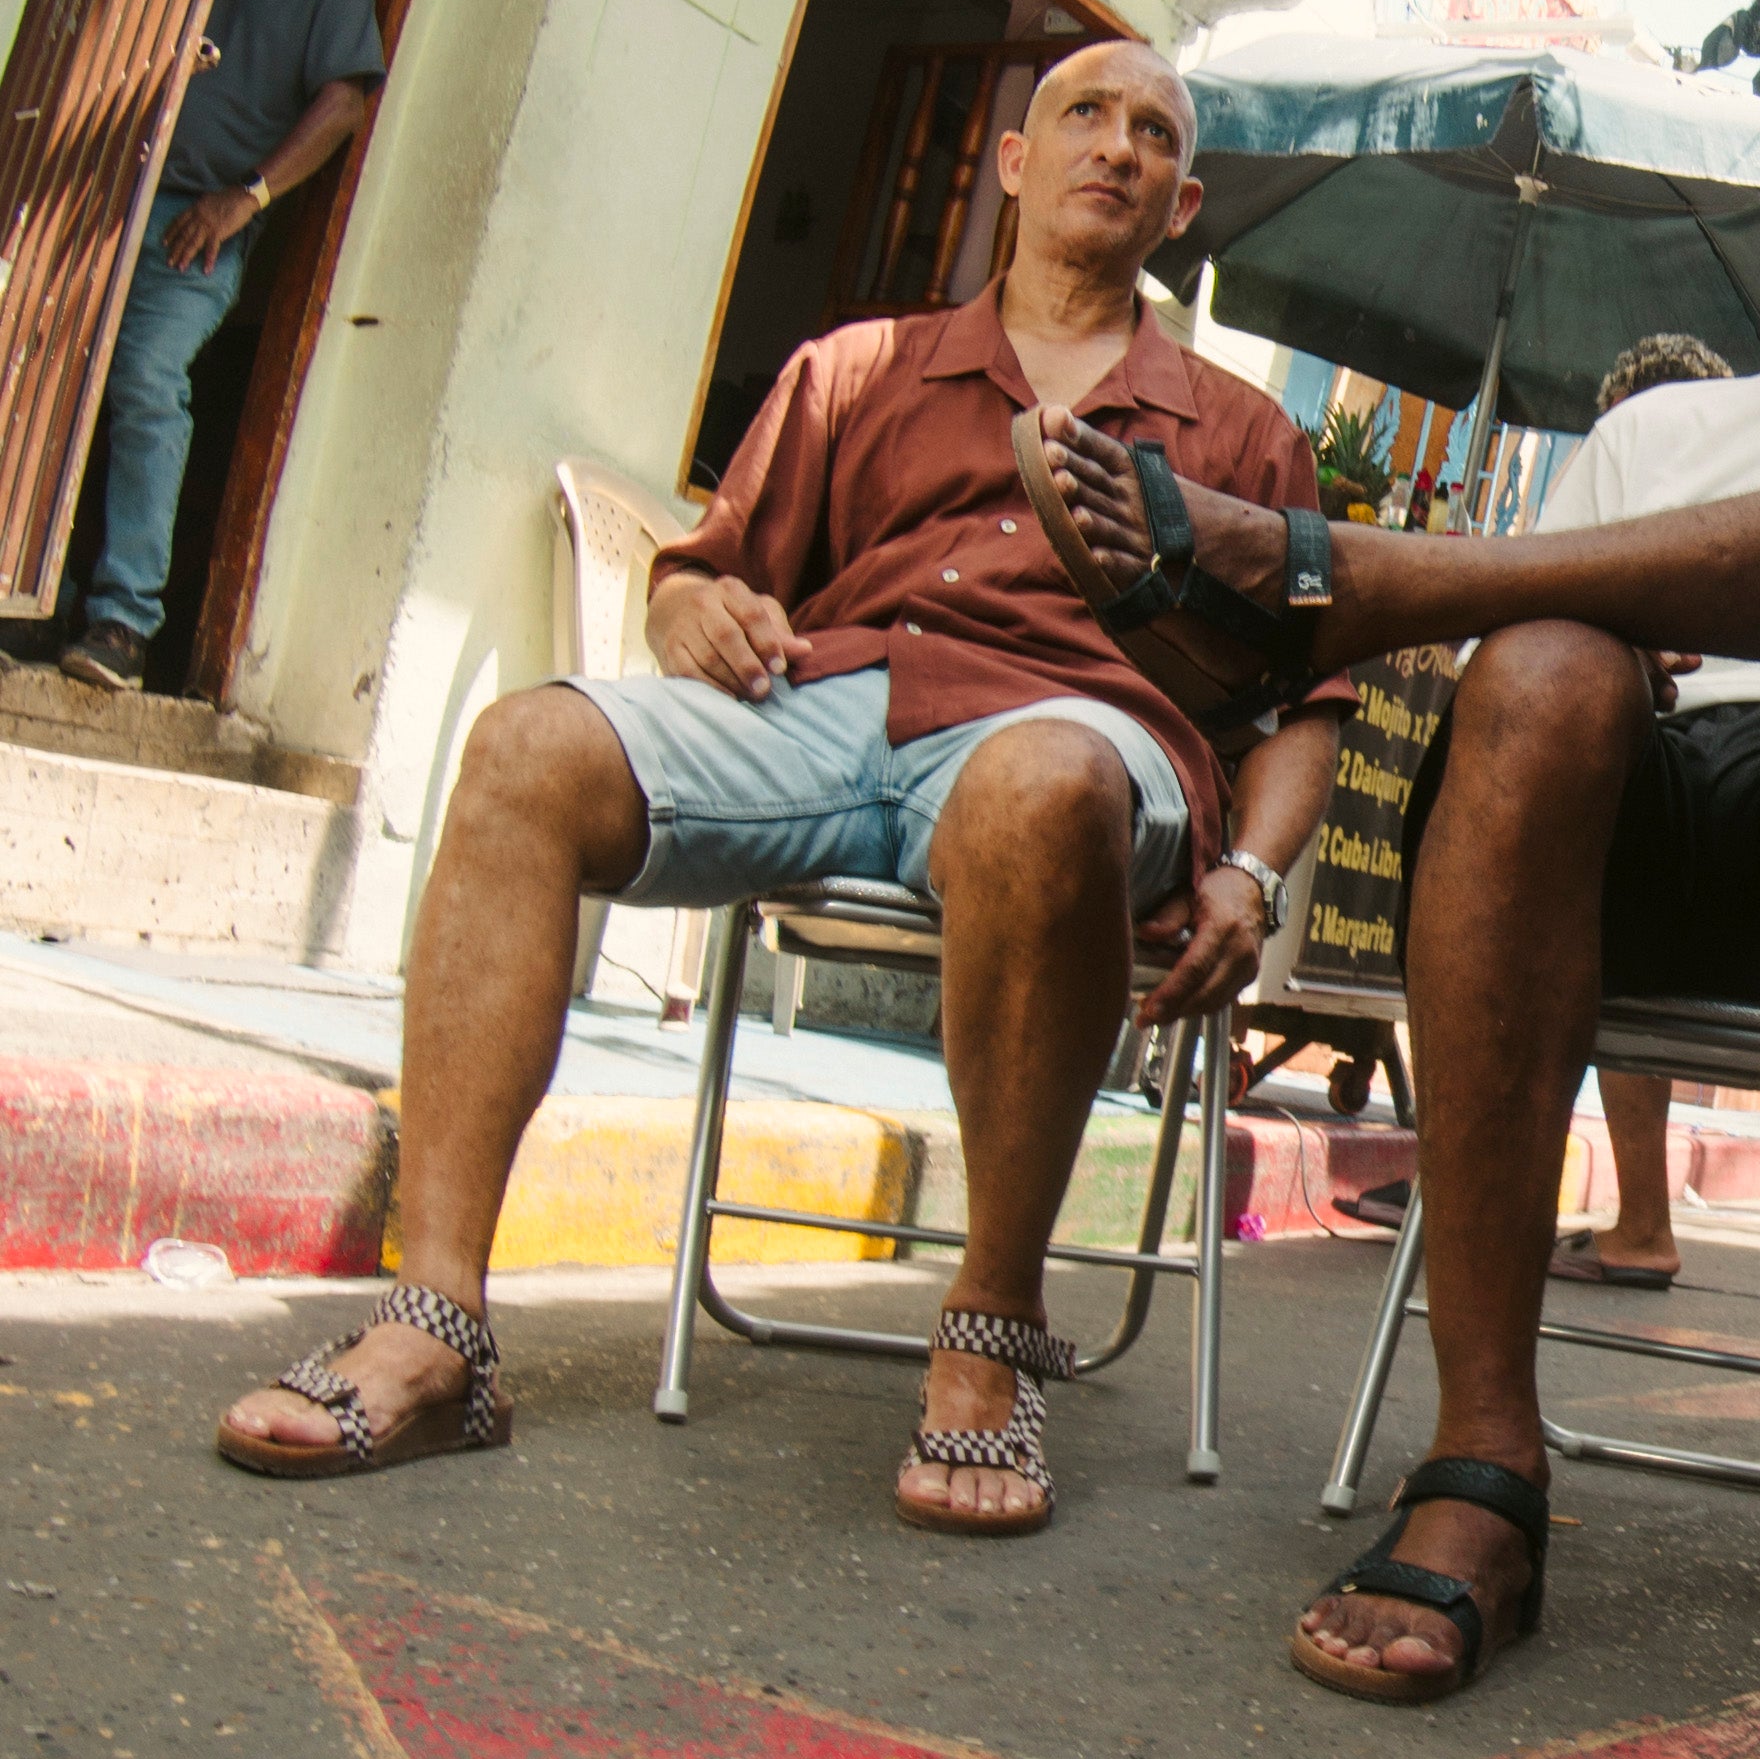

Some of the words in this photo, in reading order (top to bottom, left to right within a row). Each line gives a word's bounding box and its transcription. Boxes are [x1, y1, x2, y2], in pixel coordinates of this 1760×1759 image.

[1355, 681, 1369, 721] 2
[1367, 685, 1411, 741] Mojito
[1336, 747, 1351, 787] 2
[1318, 822, 1329, 862] 2
[1330, 825, 1370, 874] Cuba
[1310, 903, 1322, 942] 2
[1322, 904, 1394, 959] Margarita
